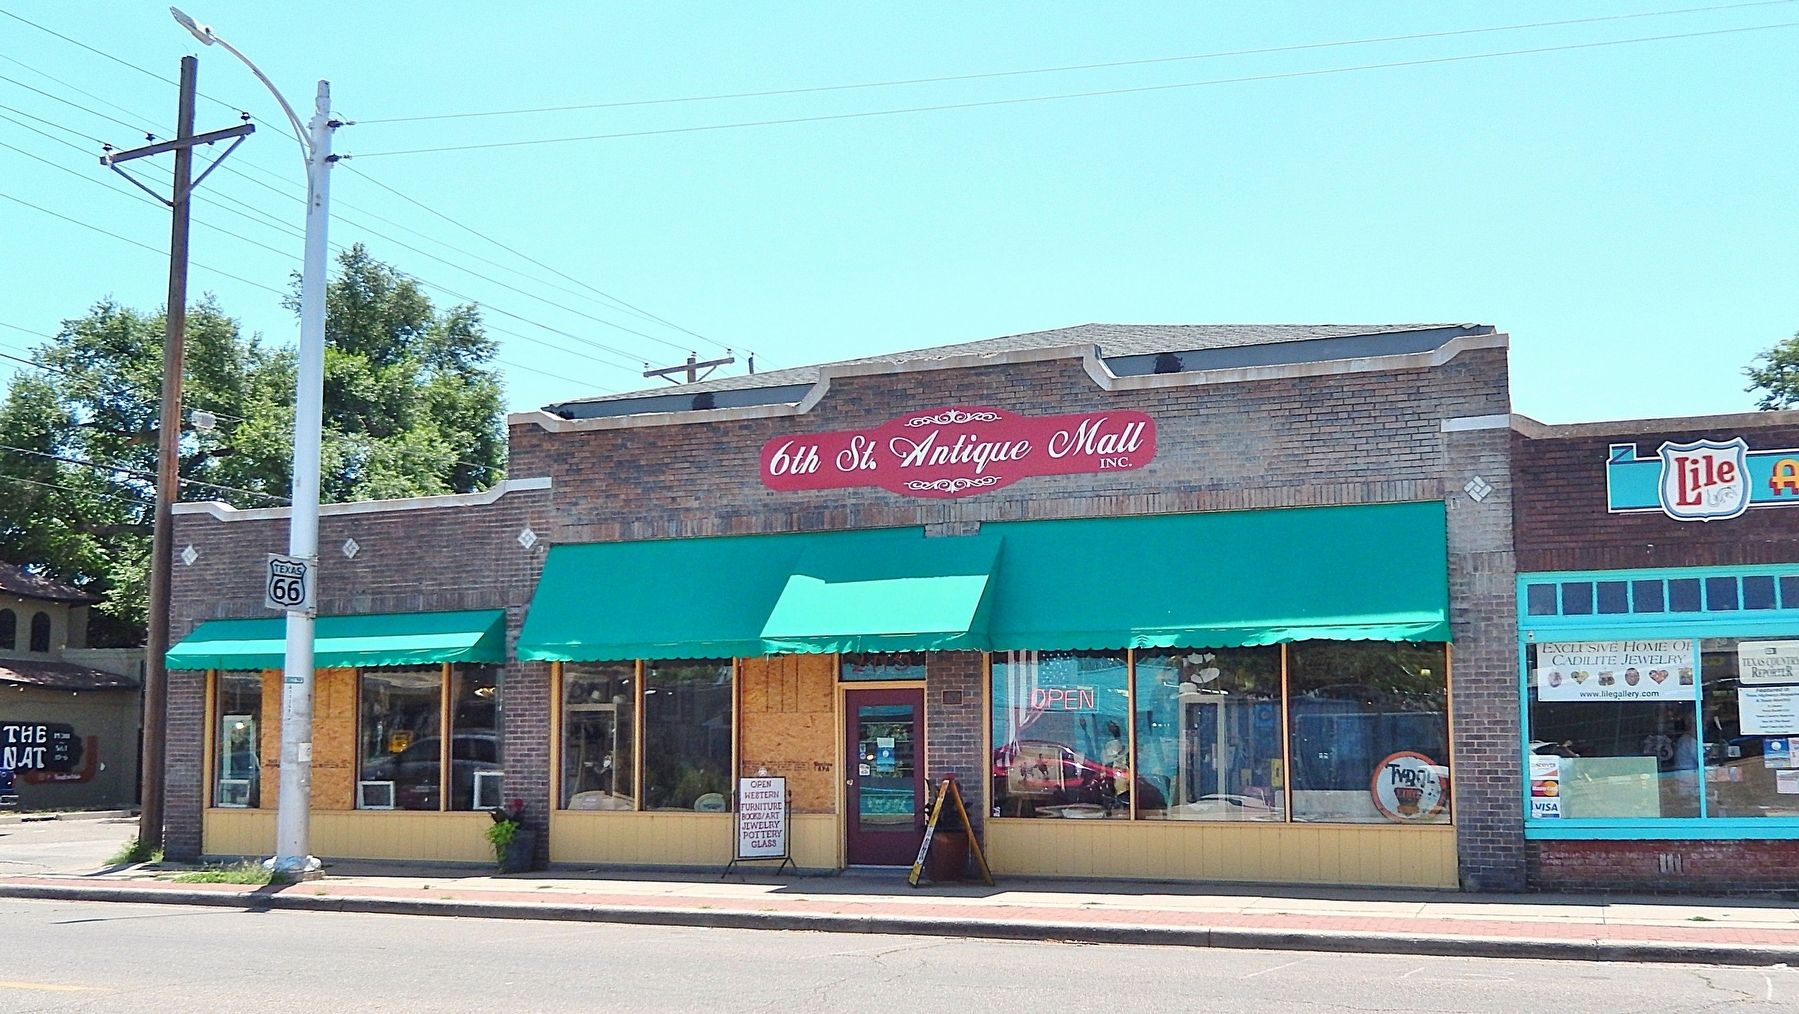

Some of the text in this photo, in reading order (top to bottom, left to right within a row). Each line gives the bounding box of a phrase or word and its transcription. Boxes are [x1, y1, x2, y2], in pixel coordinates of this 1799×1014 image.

[769, 417, 1145, 476] 6th St. Antique Mall
[1100, 457, 1132, 469] INC.
[1674, 455, 1735, 506] Lile
[274, 563, 303, 575] TEXAS
[273, 578, 300, 601] 66
[1542, 642, 1618, 654] EXCLUSIVE
[1623, 641, 1668, 652] HOME
[1552, 653, 1687, 666] CADILITE JEWELRY
[1031, 688, 1094, 710] OPEN
[1579, 690, 1660, 699] www.lilegallery.com
[3, 725, 47, 743] THE
[3, 746, 47, 770] NAT
[1385, 763, 1435, 788] TYDOL
[750, 780, 772, 789] OPEN
[744, 790, 780, 800] WESTERN
[740, 802, 782, 811] FURNITURE
[1534, 803, 1559, 812] VISA
[741, 812, 780, 821] BOOKS/ART
[742, 821, 780, 830] JEWELRY
[743, 829, 782, 839] POTTERY
[751, 839, 777, 848] GLASS
